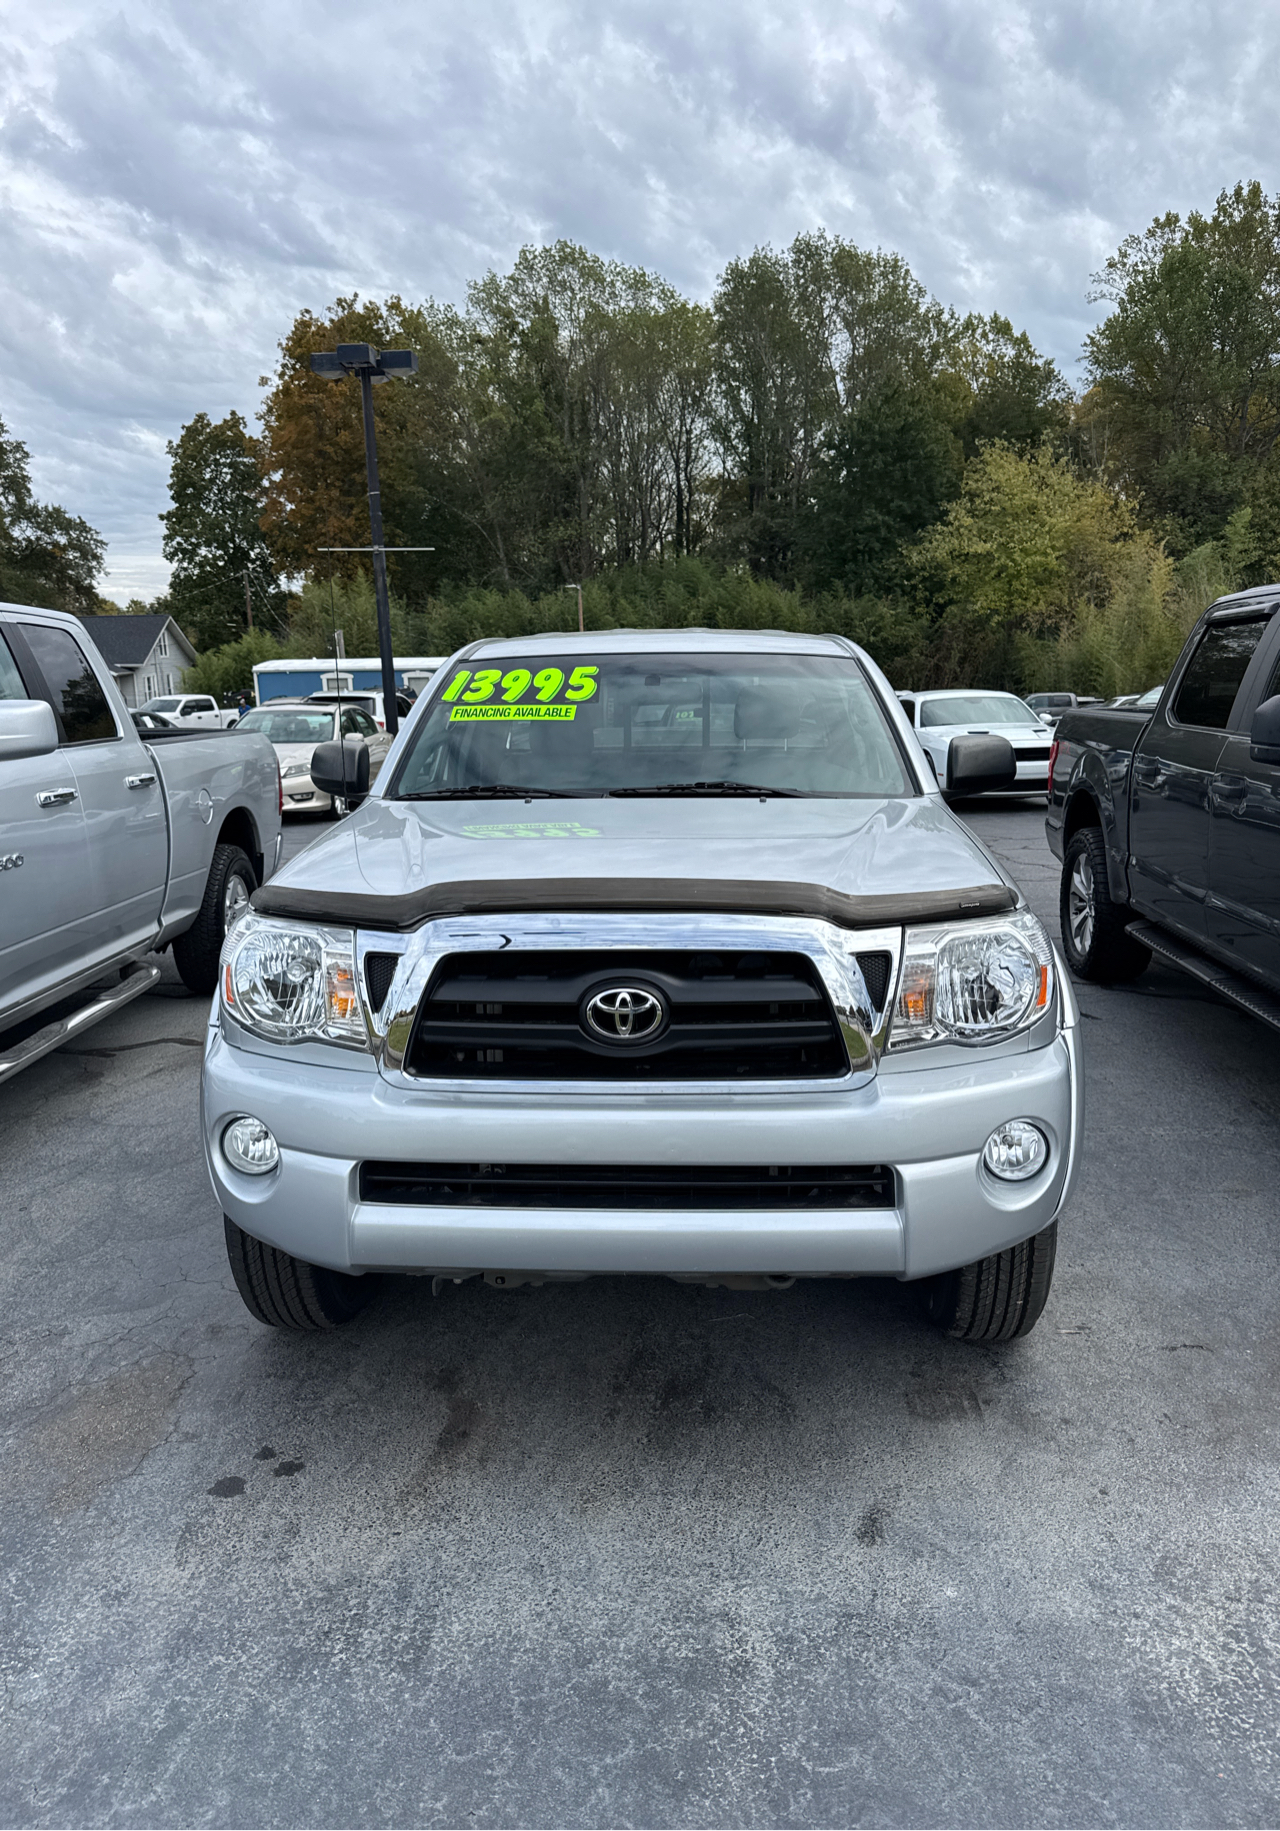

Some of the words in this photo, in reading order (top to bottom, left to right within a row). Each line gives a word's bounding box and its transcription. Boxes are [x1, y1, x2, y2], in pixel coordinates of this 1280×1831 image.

[441, 666, 600, 703] 13995
[454, 707, 511, 718] FINANCING
[513, 707, 572, 718] AVAILABLE
